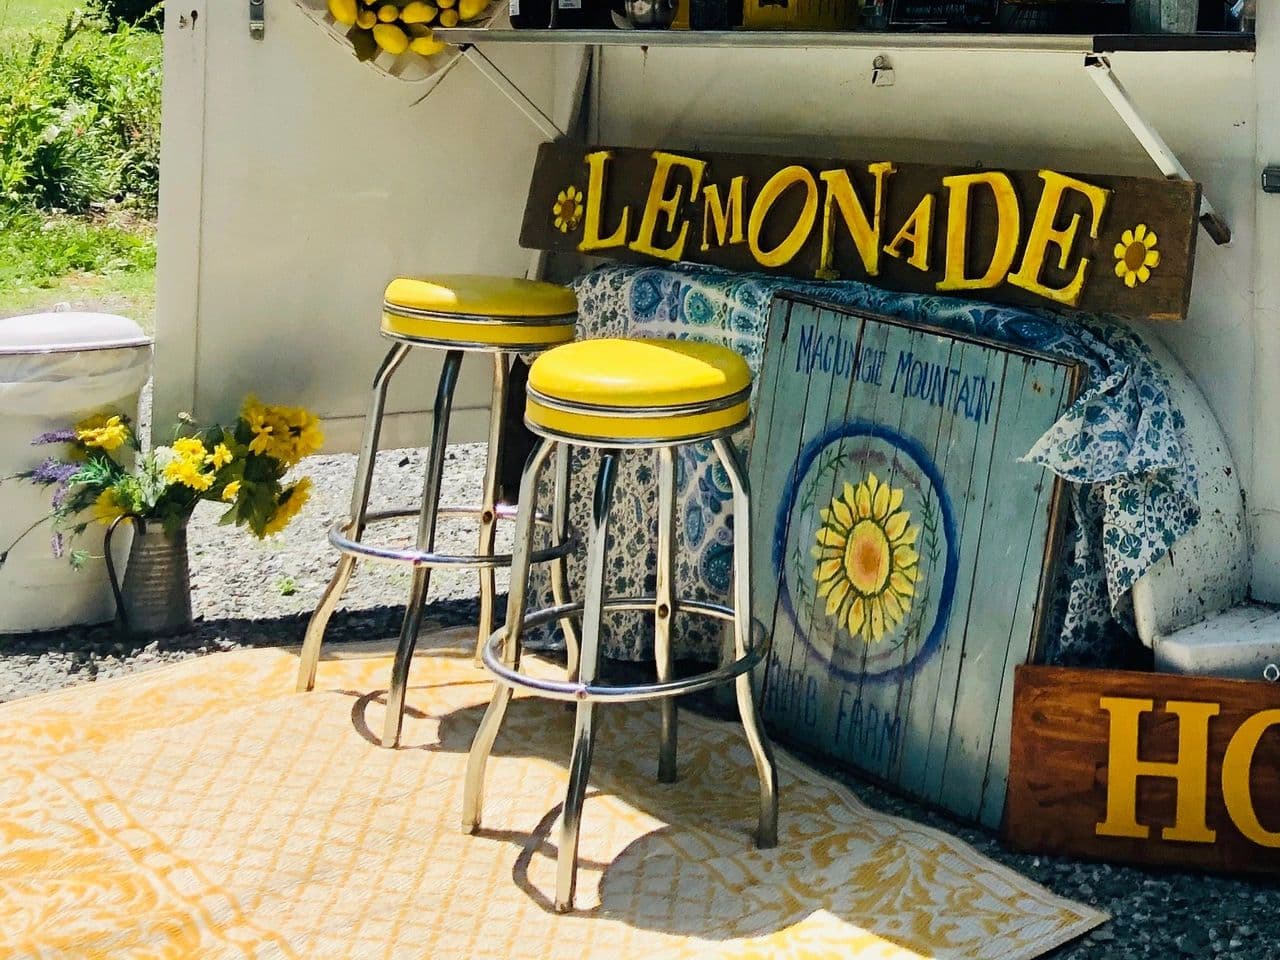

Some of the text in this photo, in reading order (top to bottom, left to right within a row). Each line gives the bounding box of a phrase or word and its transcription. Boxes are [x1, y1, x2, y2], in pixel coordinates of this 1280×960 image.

[578, 150, 1110, 307] LEMONADE
[795, 323, 996, 425] MACUNGIE MOUNTAIN
[835, 688, 902, 765] FARM
